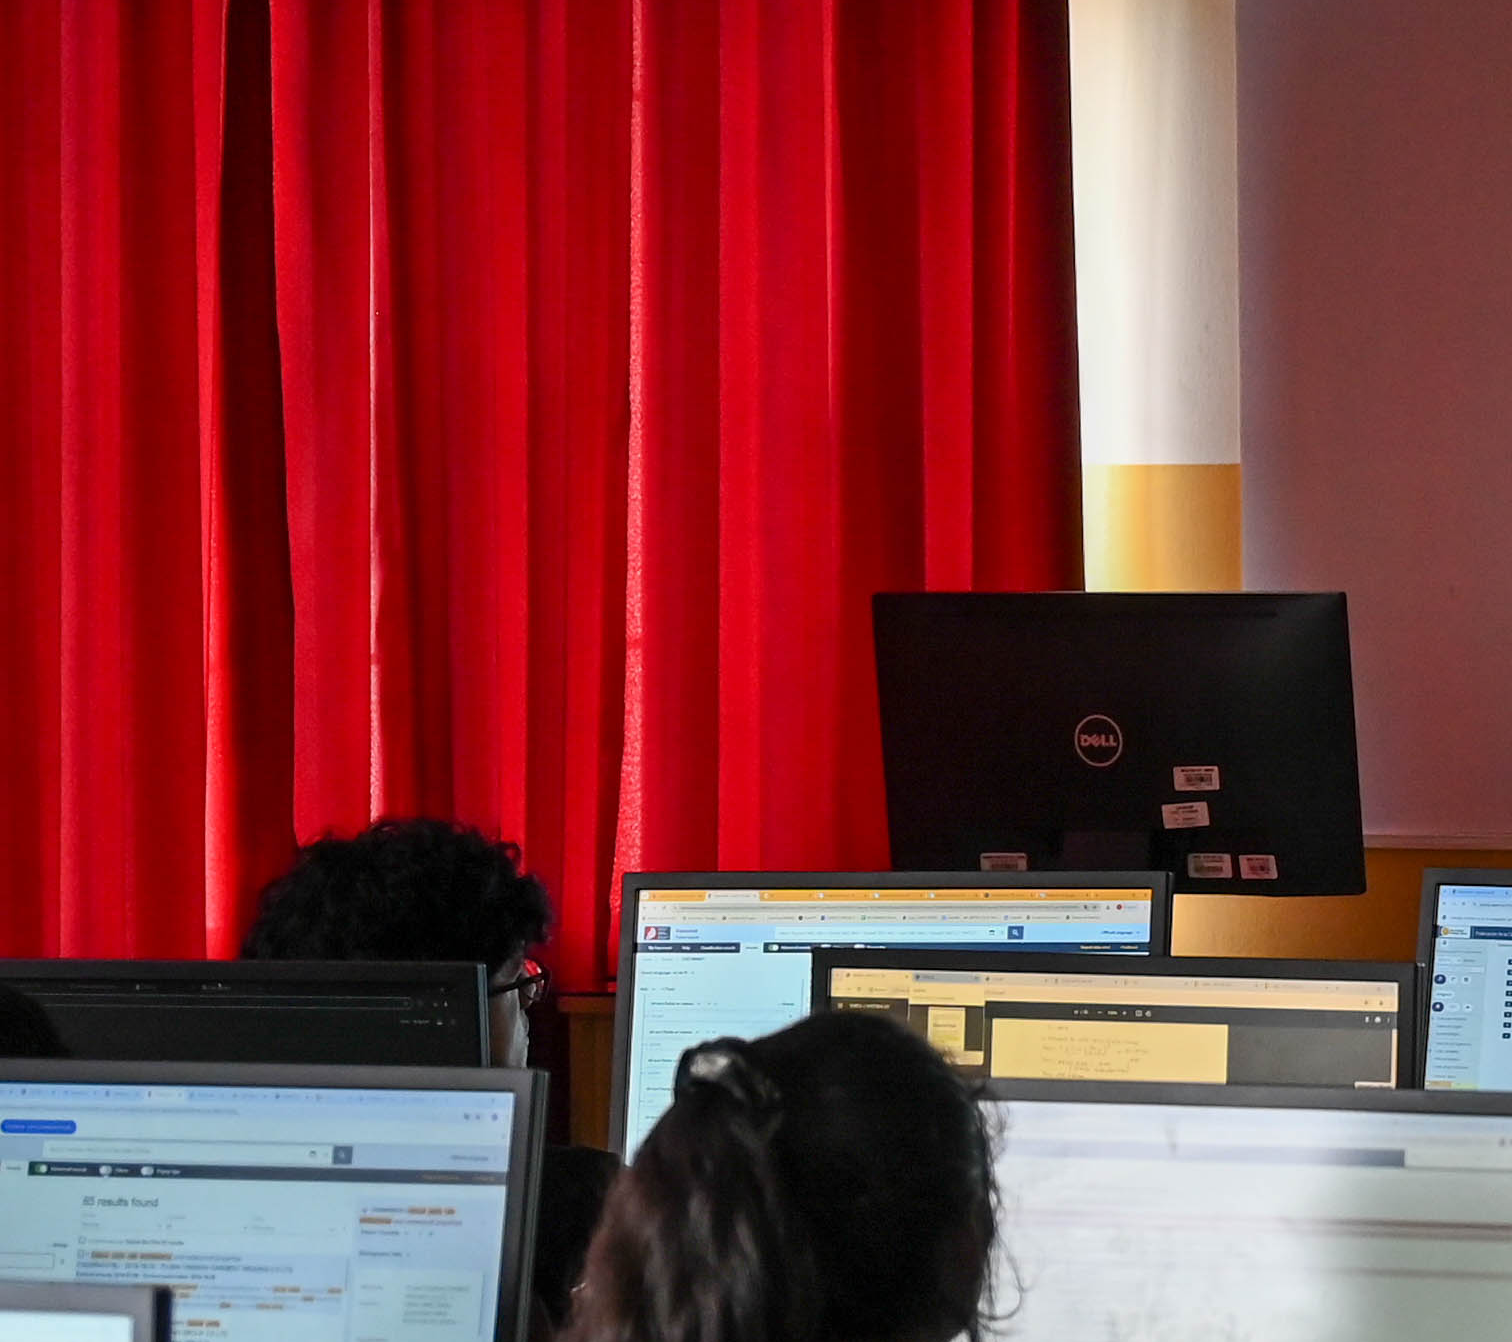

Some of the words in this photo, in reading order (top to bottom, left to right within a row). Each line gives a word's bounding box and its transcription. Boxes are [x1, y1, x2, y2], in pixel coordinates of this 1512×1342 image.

[1080, 734, 1117, 747] DELL
[97, 1197, 129, 1207] results
[131, 1198, 158, 1208] found
